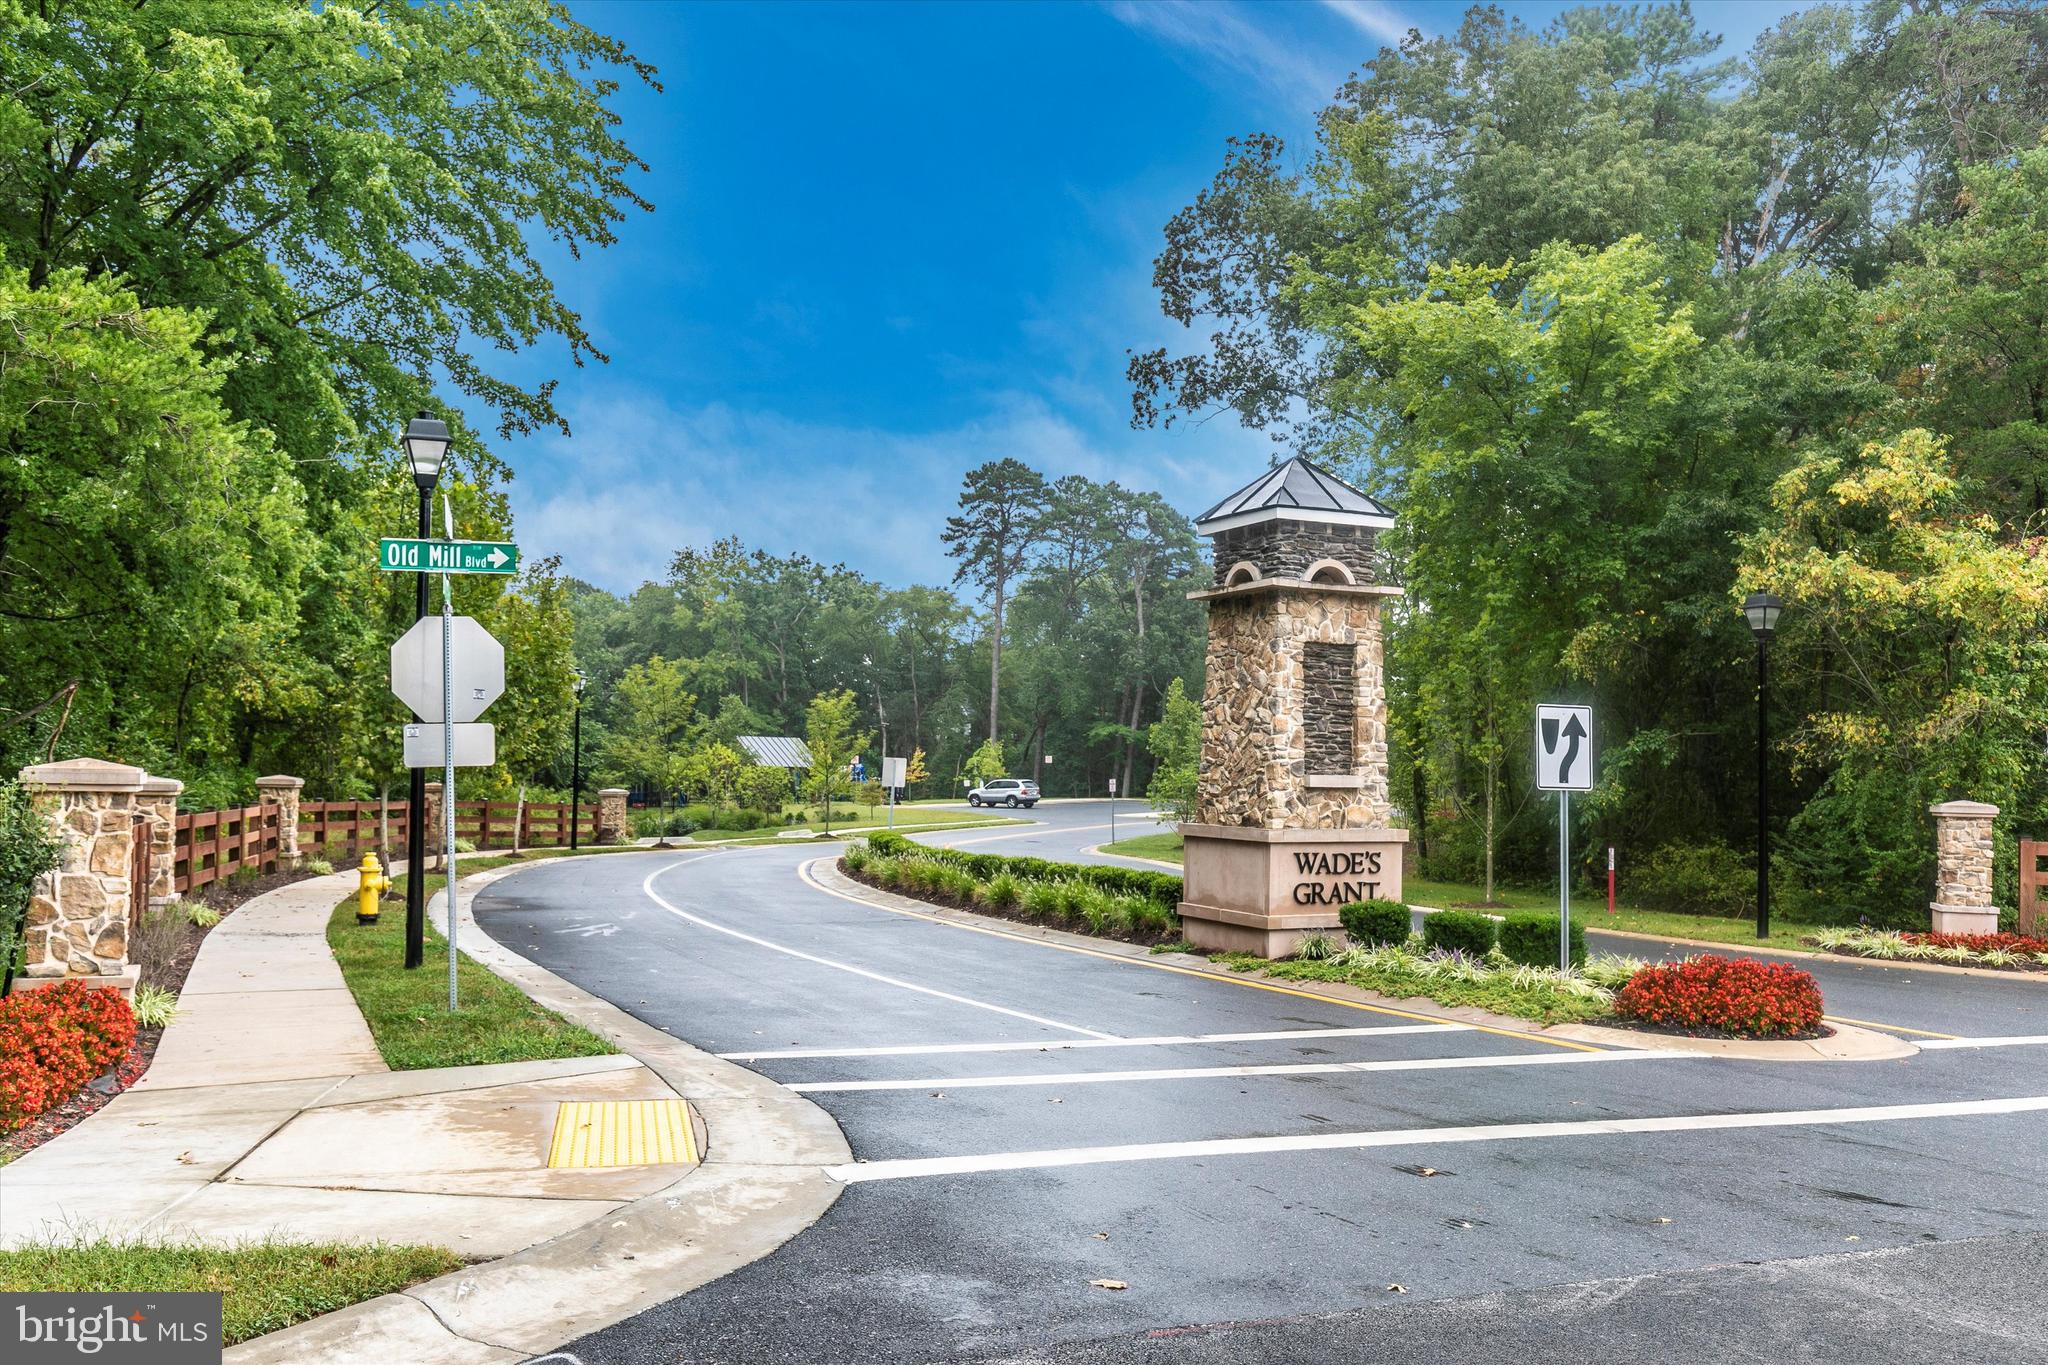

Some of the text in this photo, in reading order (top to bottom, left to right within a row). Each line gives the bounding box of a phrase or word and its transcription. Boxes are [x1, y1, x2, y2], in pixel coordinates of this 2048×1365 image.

[387, 543, 487, 568] Old Mill Blvd
[1293, 851, 1382, 875] WADE'S
[1293, 881, 1381, 905] GRANT
